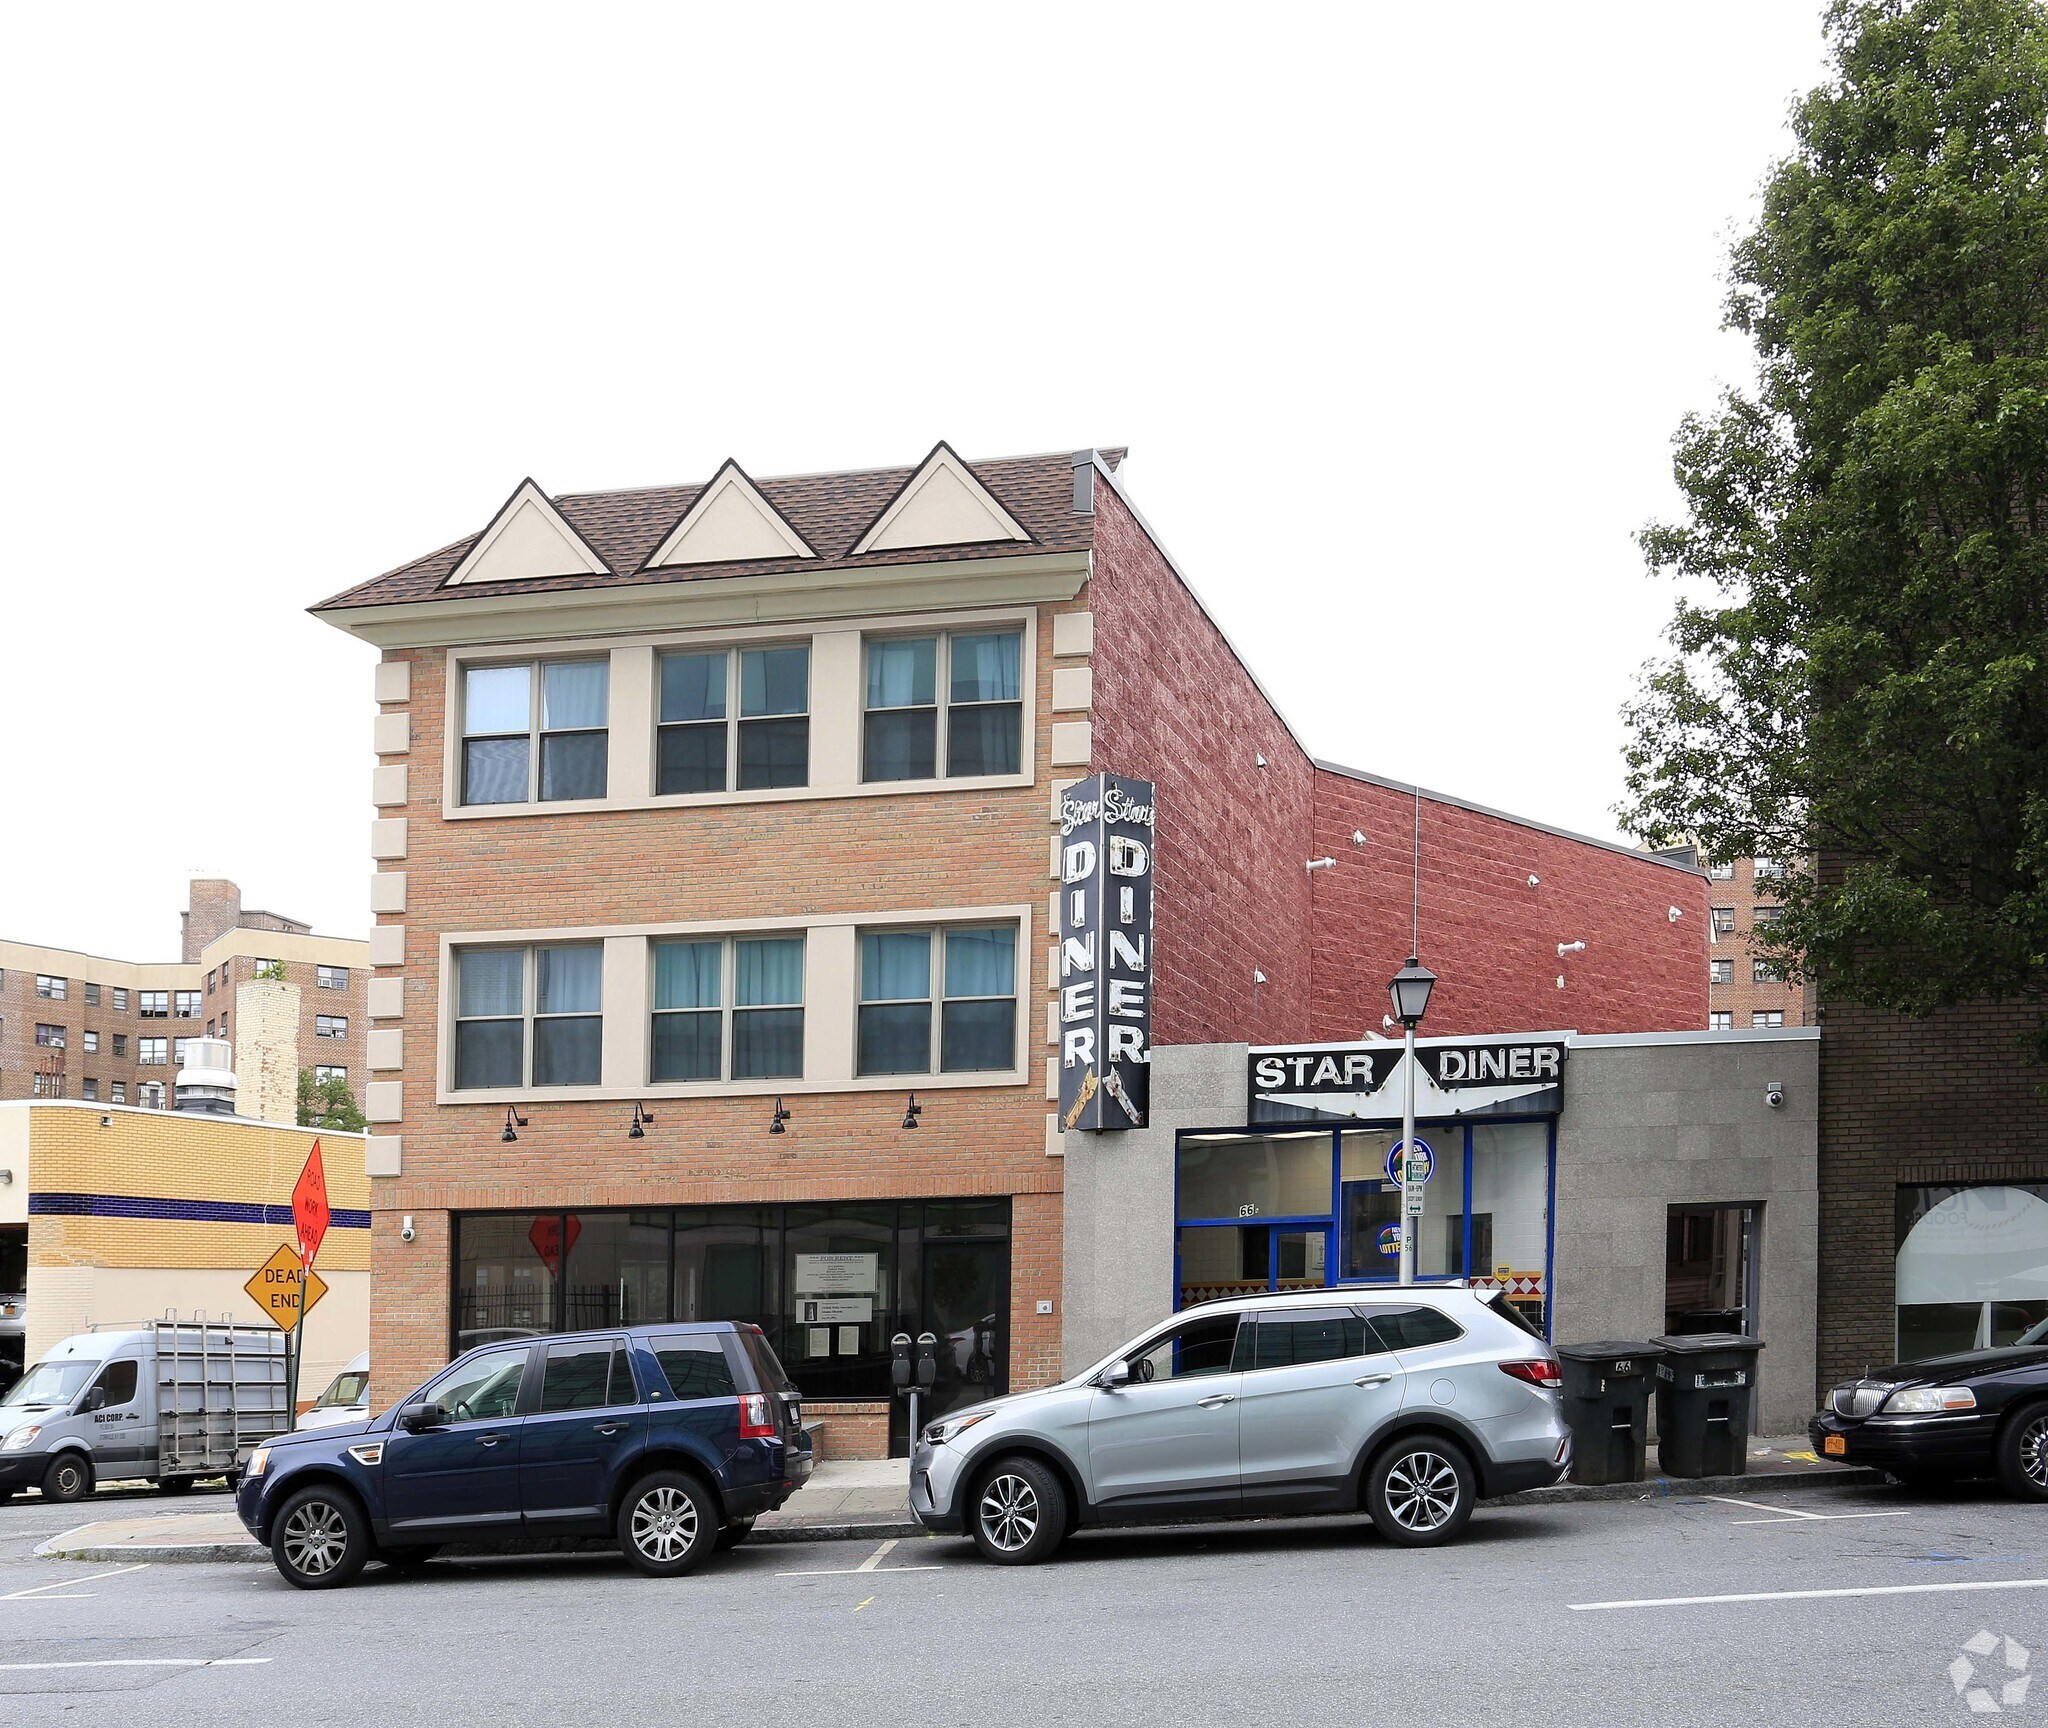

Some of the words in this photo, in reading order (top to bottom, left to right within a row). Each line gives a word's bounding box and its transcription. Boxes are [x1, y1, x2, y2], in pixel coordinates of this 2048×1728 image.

[1104, 784, 1155, 826] Star
[1061, 840, 1097, 1069] DINER
[1108, 834, 1150, 1064] DINER
[1255, 1054, 1374, 1088] STAR
[1439, 1047, 1560, 1081] DINER
[307, 1169, 321, 1190] ROAD
[304, 1196, 318, 1218] WORK
[1240, 1205, 1253, 1216] 66
[301, 1222, 318, 1245] AHEAD
[1406, 1236, 1412, 1244] P
[1379, 1241, 1401, 1254] LOTTE
[1404, 1244, 1413, 1252] 56
[271, 1293, 301, 1309] END
[1617, 1362, 1631, 1372] 66
[94, 1414, 105, 1423] ACI
